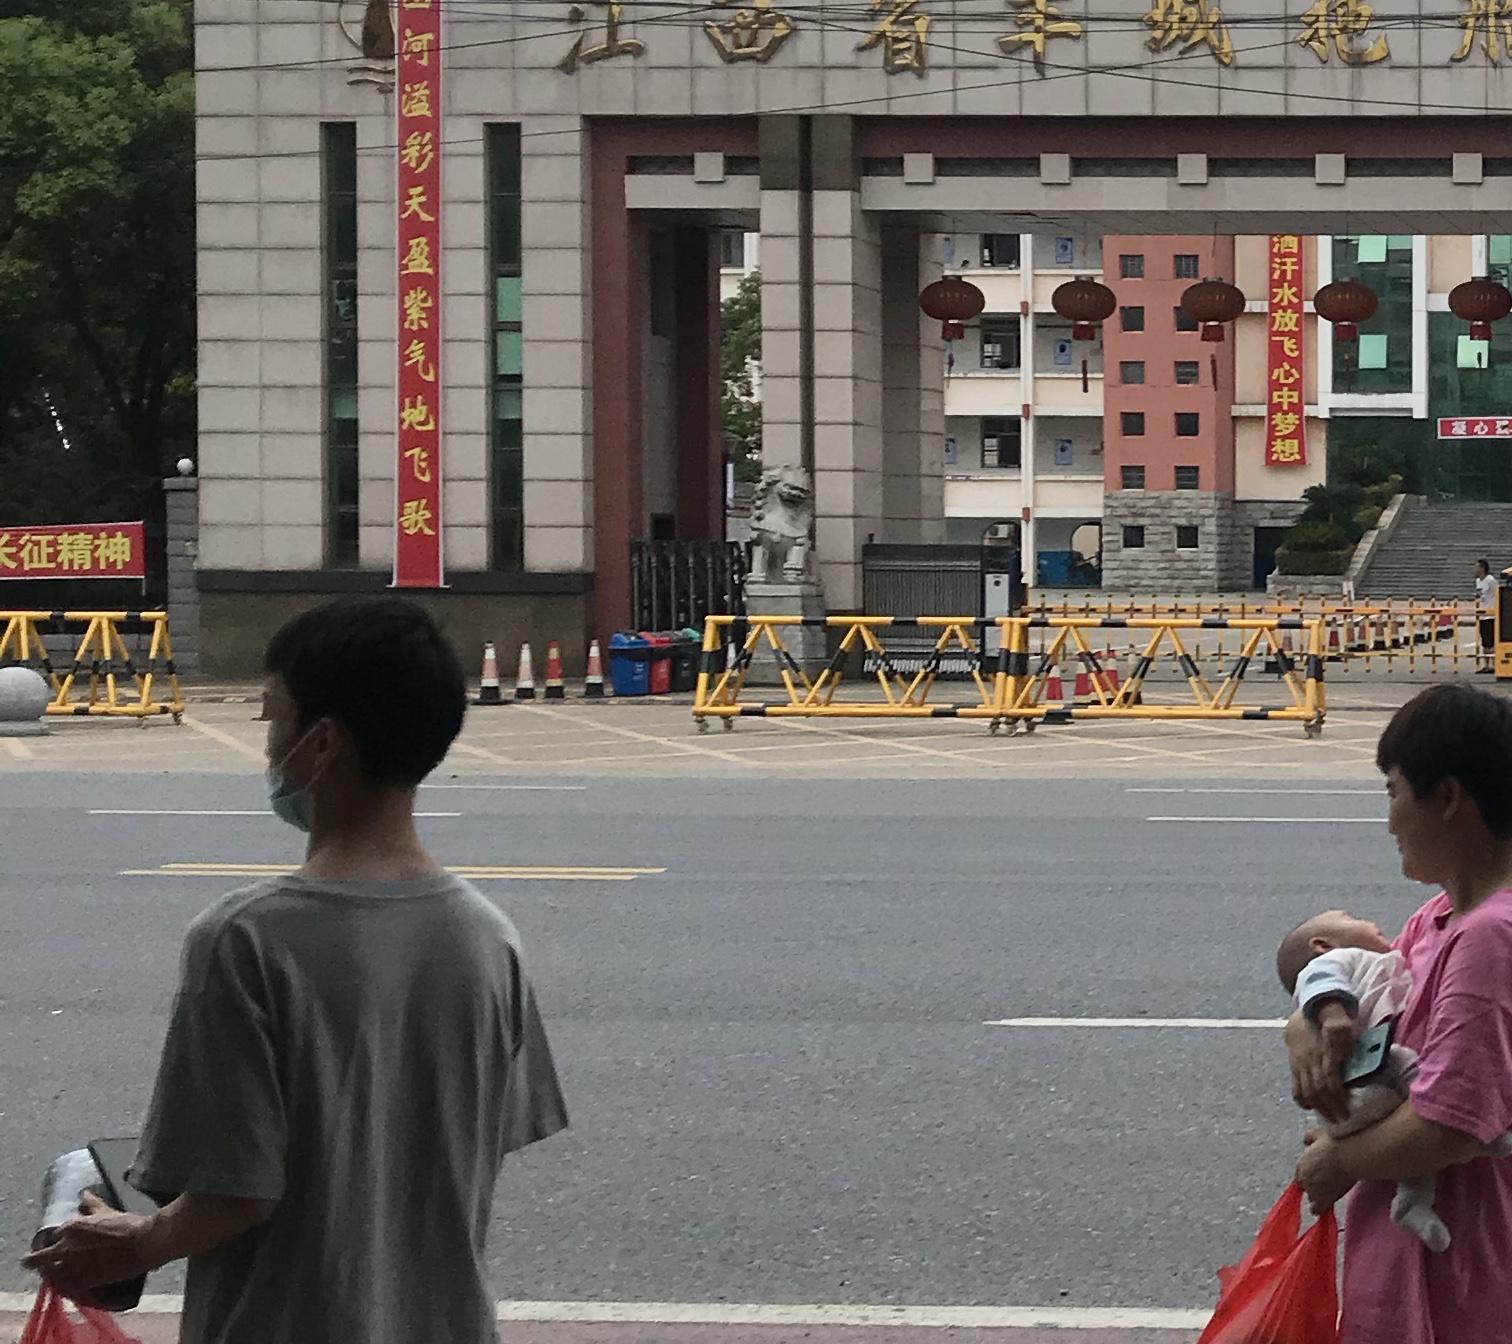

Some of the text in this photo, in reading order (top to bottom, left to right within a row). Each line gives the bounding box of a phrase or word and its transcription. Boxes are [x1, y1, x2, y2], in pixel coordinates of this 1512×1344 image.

[1272, 234, 1302, 462] 洒汗水放飞心中梦想
